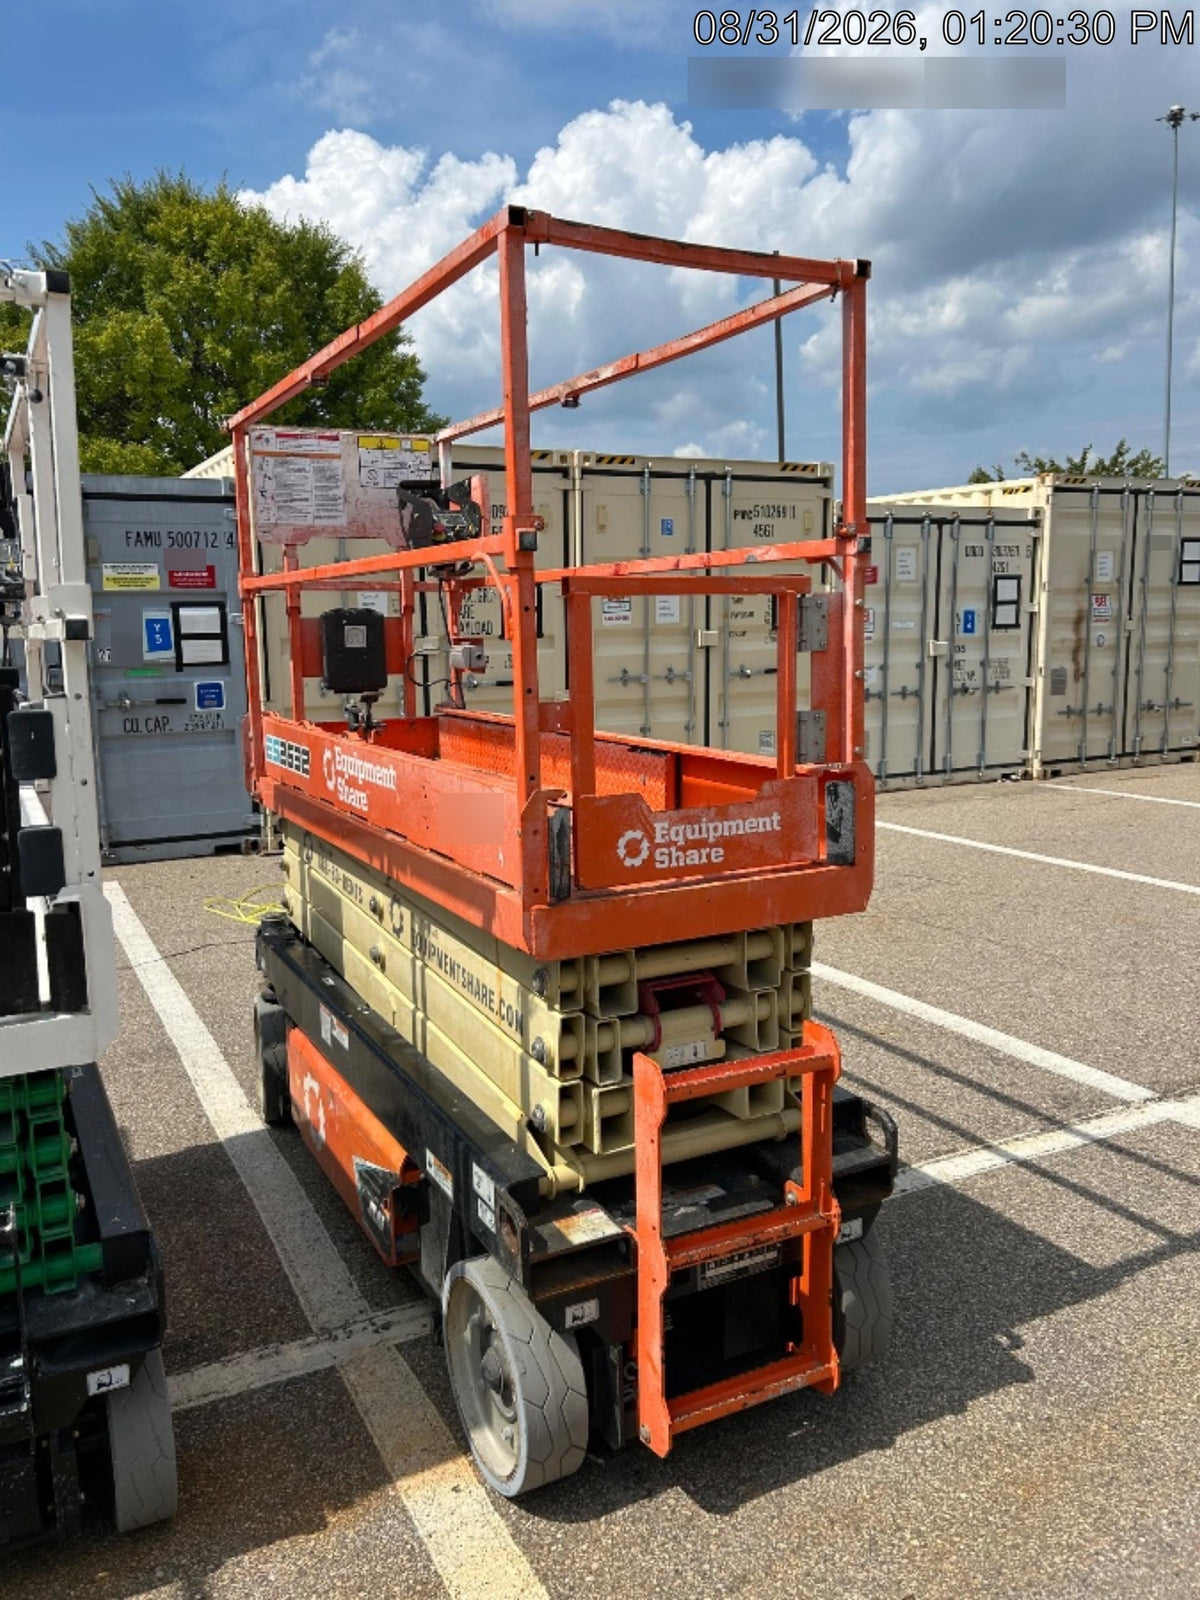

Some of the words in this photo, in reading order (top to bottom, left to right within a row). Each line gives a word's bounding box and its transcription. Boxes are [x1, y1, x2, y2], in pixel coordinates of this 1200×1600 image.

[125, 531, 162, 548] FAMU
[167, 531, 219, 548] 500712
[225, 532, 236, 548] 4
[153, 623, 161, 632] Y
[155, 634, 163, 645] 5
[334, 745, 398, 790] Equipment
[336, 776, 369, 811] Share
[653, 811, 782, 845] Equipment
[654, 846, 725, 869] Share
